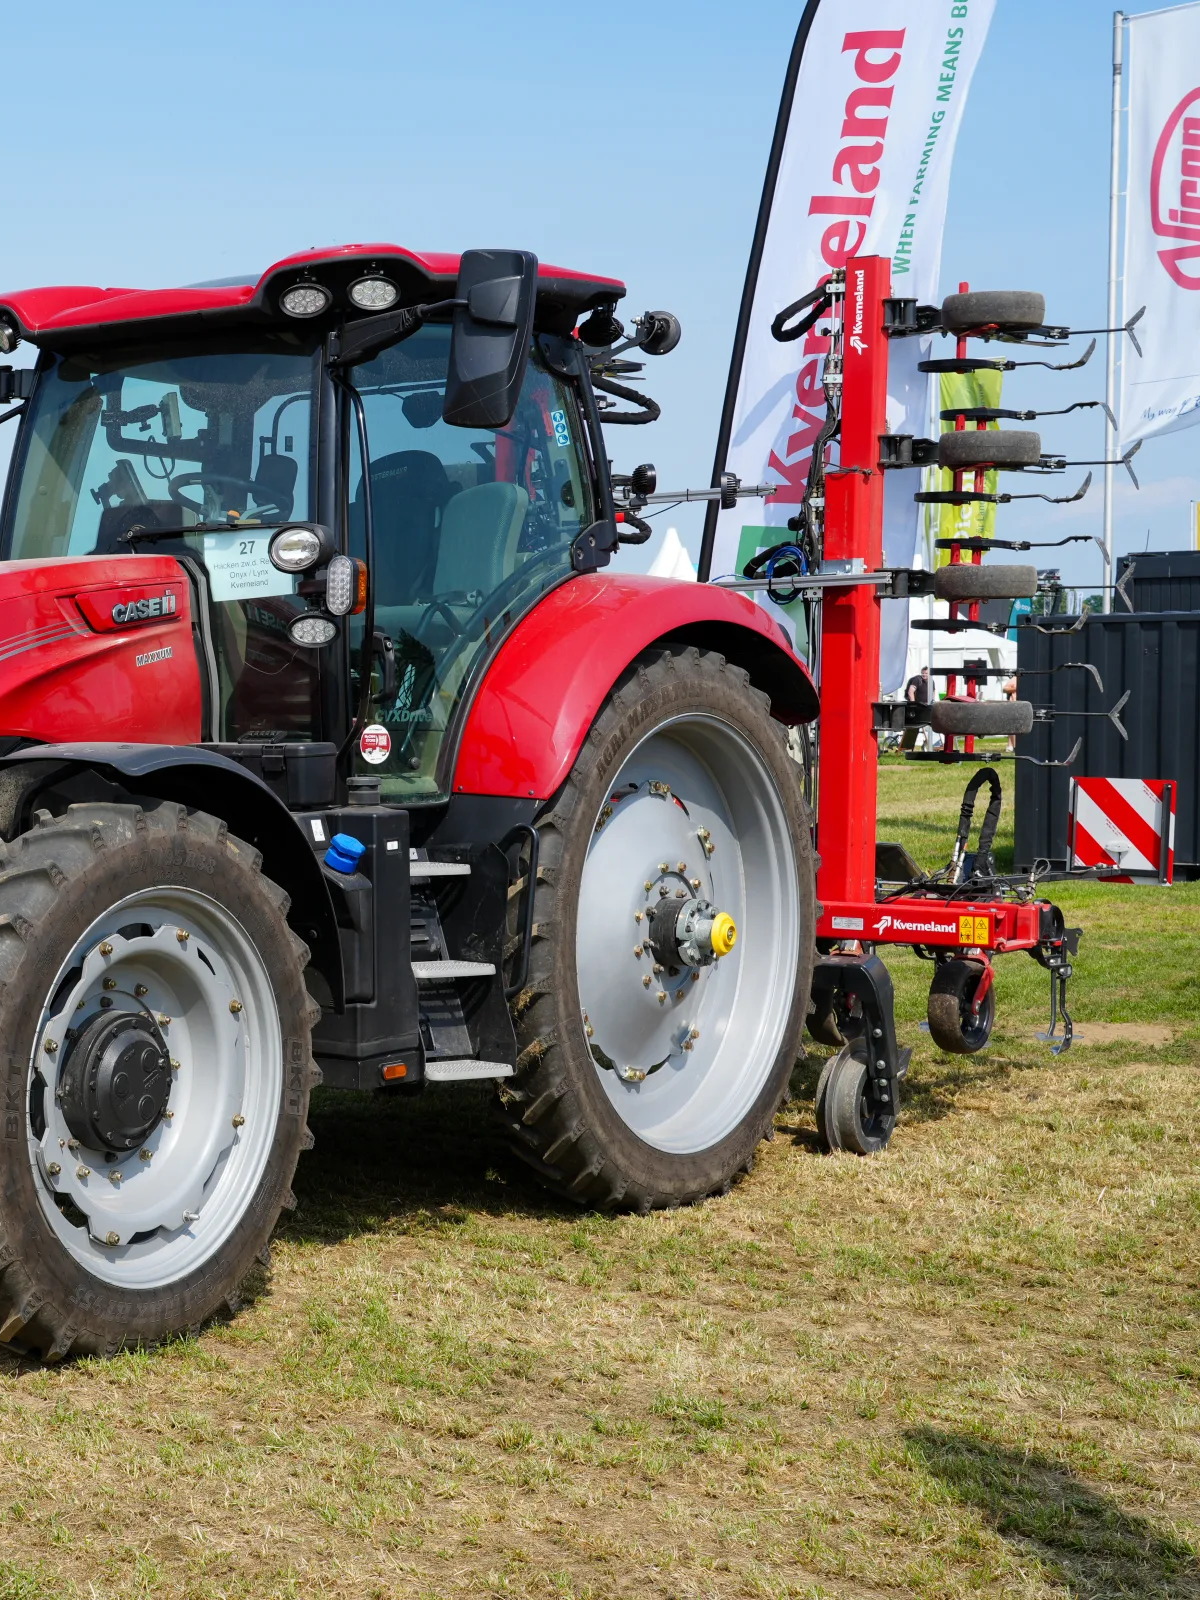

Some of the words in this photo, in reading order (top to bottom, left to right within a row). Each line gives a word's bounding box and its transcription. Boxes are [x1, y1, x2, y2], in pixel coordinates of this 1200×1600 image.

[892, 213, 916, 275] WHEN
[908, 110, 946, 206] FARMING
[935, 27, 964, 102] MEANS
[950, 0, 969, 18] B
[852, 269, 866, 335] Kverneland
[239, 540, 256, 555] 27
[213, 561, 240, 570] Hacken
[229, 570, 247, 581] Onyx
[253, 569, 269, 577] Lynx
[230, 579, 269, 589] Kverneland
[112, 597, 160, 624] CASE
[135, 646, 174, 668] MAXXUM
[374, 708, 433, 722] CVXDrive
[893, 918, 957, 933] Kverneland
[290, 1041, 303, 1113] BKT
[4, 1057, 22, 1140] BKT
